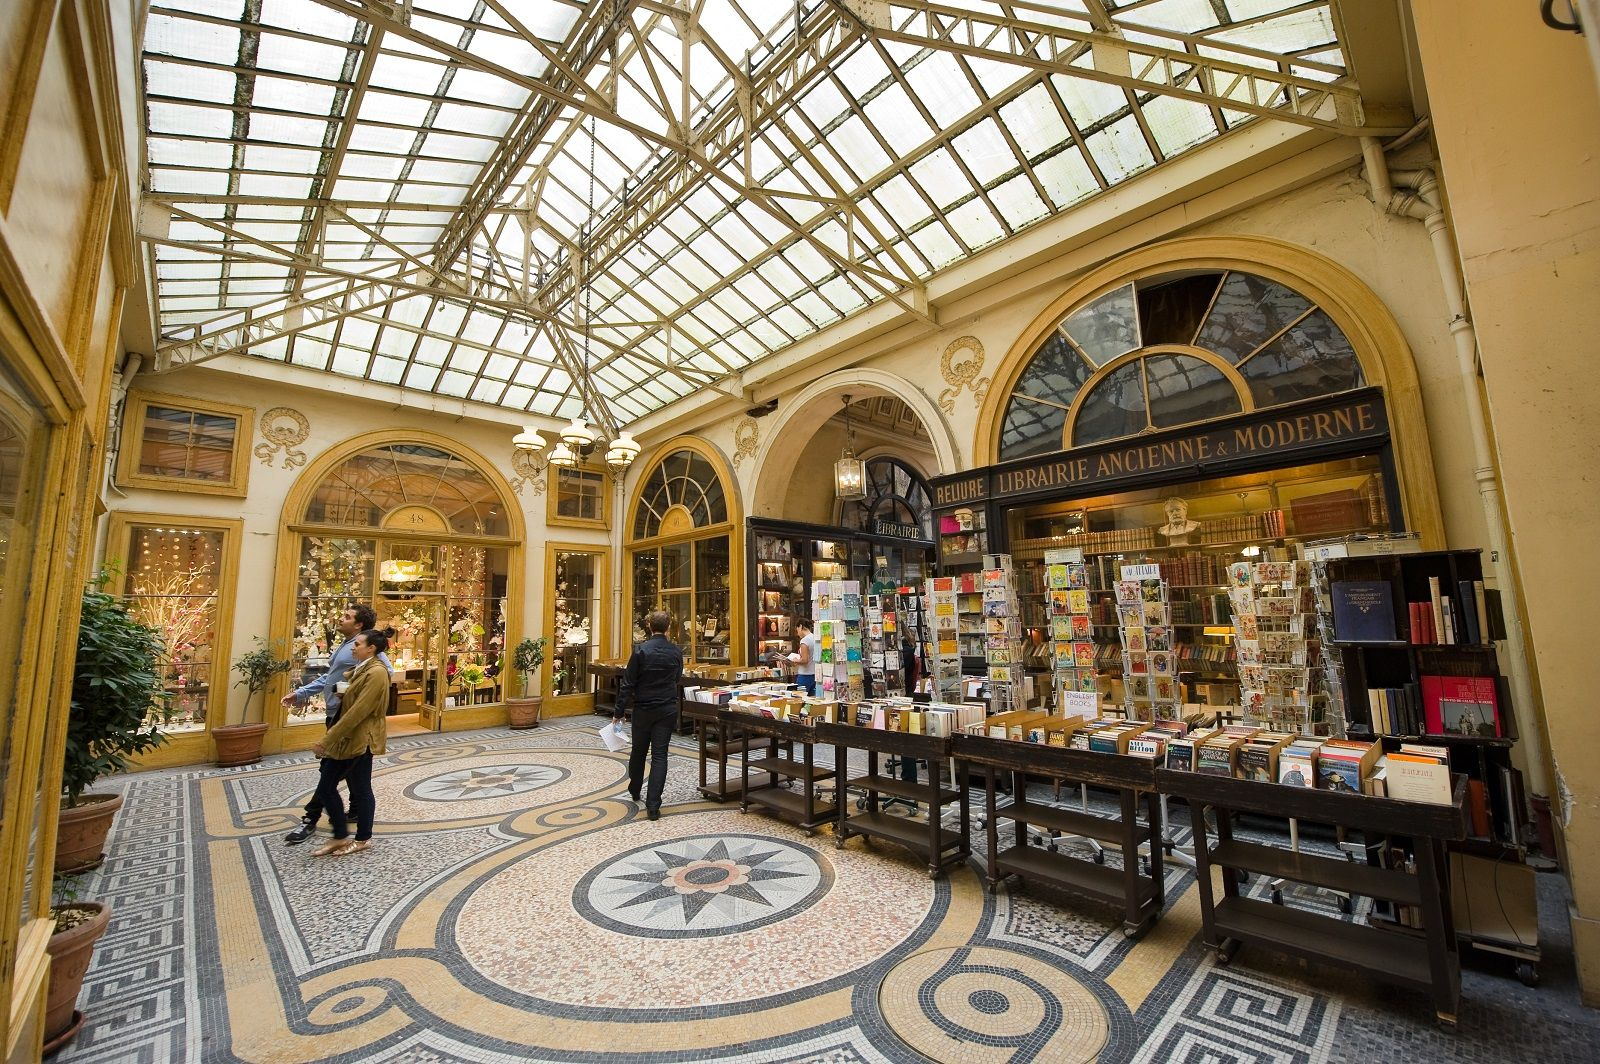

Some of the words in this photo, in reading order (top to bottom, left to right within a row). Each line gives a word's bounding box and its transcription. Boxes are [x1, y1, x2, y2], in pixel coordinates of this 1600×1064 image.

[1000, 458, 1089, 493] LIBRAIRIE
[1096, 435, 1213, 478] ANCIENNE
[1216, 441, 1228, 456] &
[1234, 403, 1376, 453] MODERNE
[936, 477, 985, 504] RELIURE
[409, 513, 424, 524] 48
[875, 520, 920, 540] LIBRAIRIE
[1066, 691, 1095, 700] ENGLISH
